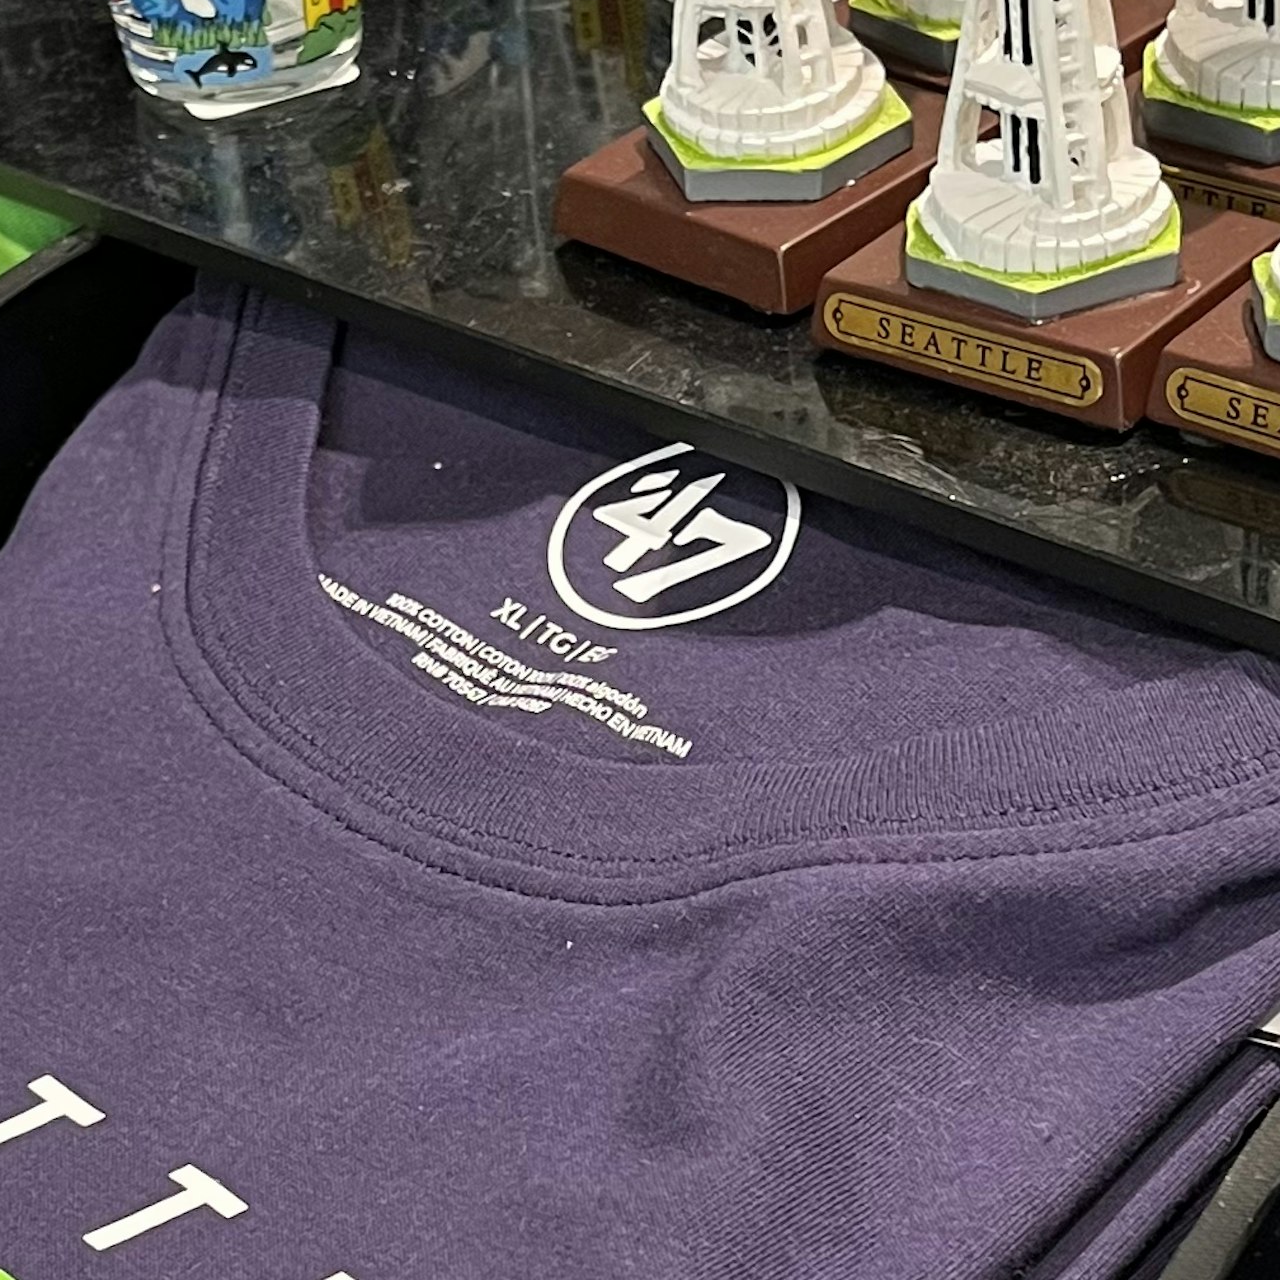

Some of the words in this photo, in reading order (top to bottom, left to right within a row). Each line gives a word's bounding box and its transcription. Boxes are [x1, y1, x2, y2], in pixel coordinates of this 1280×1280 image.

[1179, 184, 1267, 217] TTLE
[876, 317, 1043, 382] SEATTLE
[490, 597, 528, 631] XL
[537, 622, 578, 655] TG
